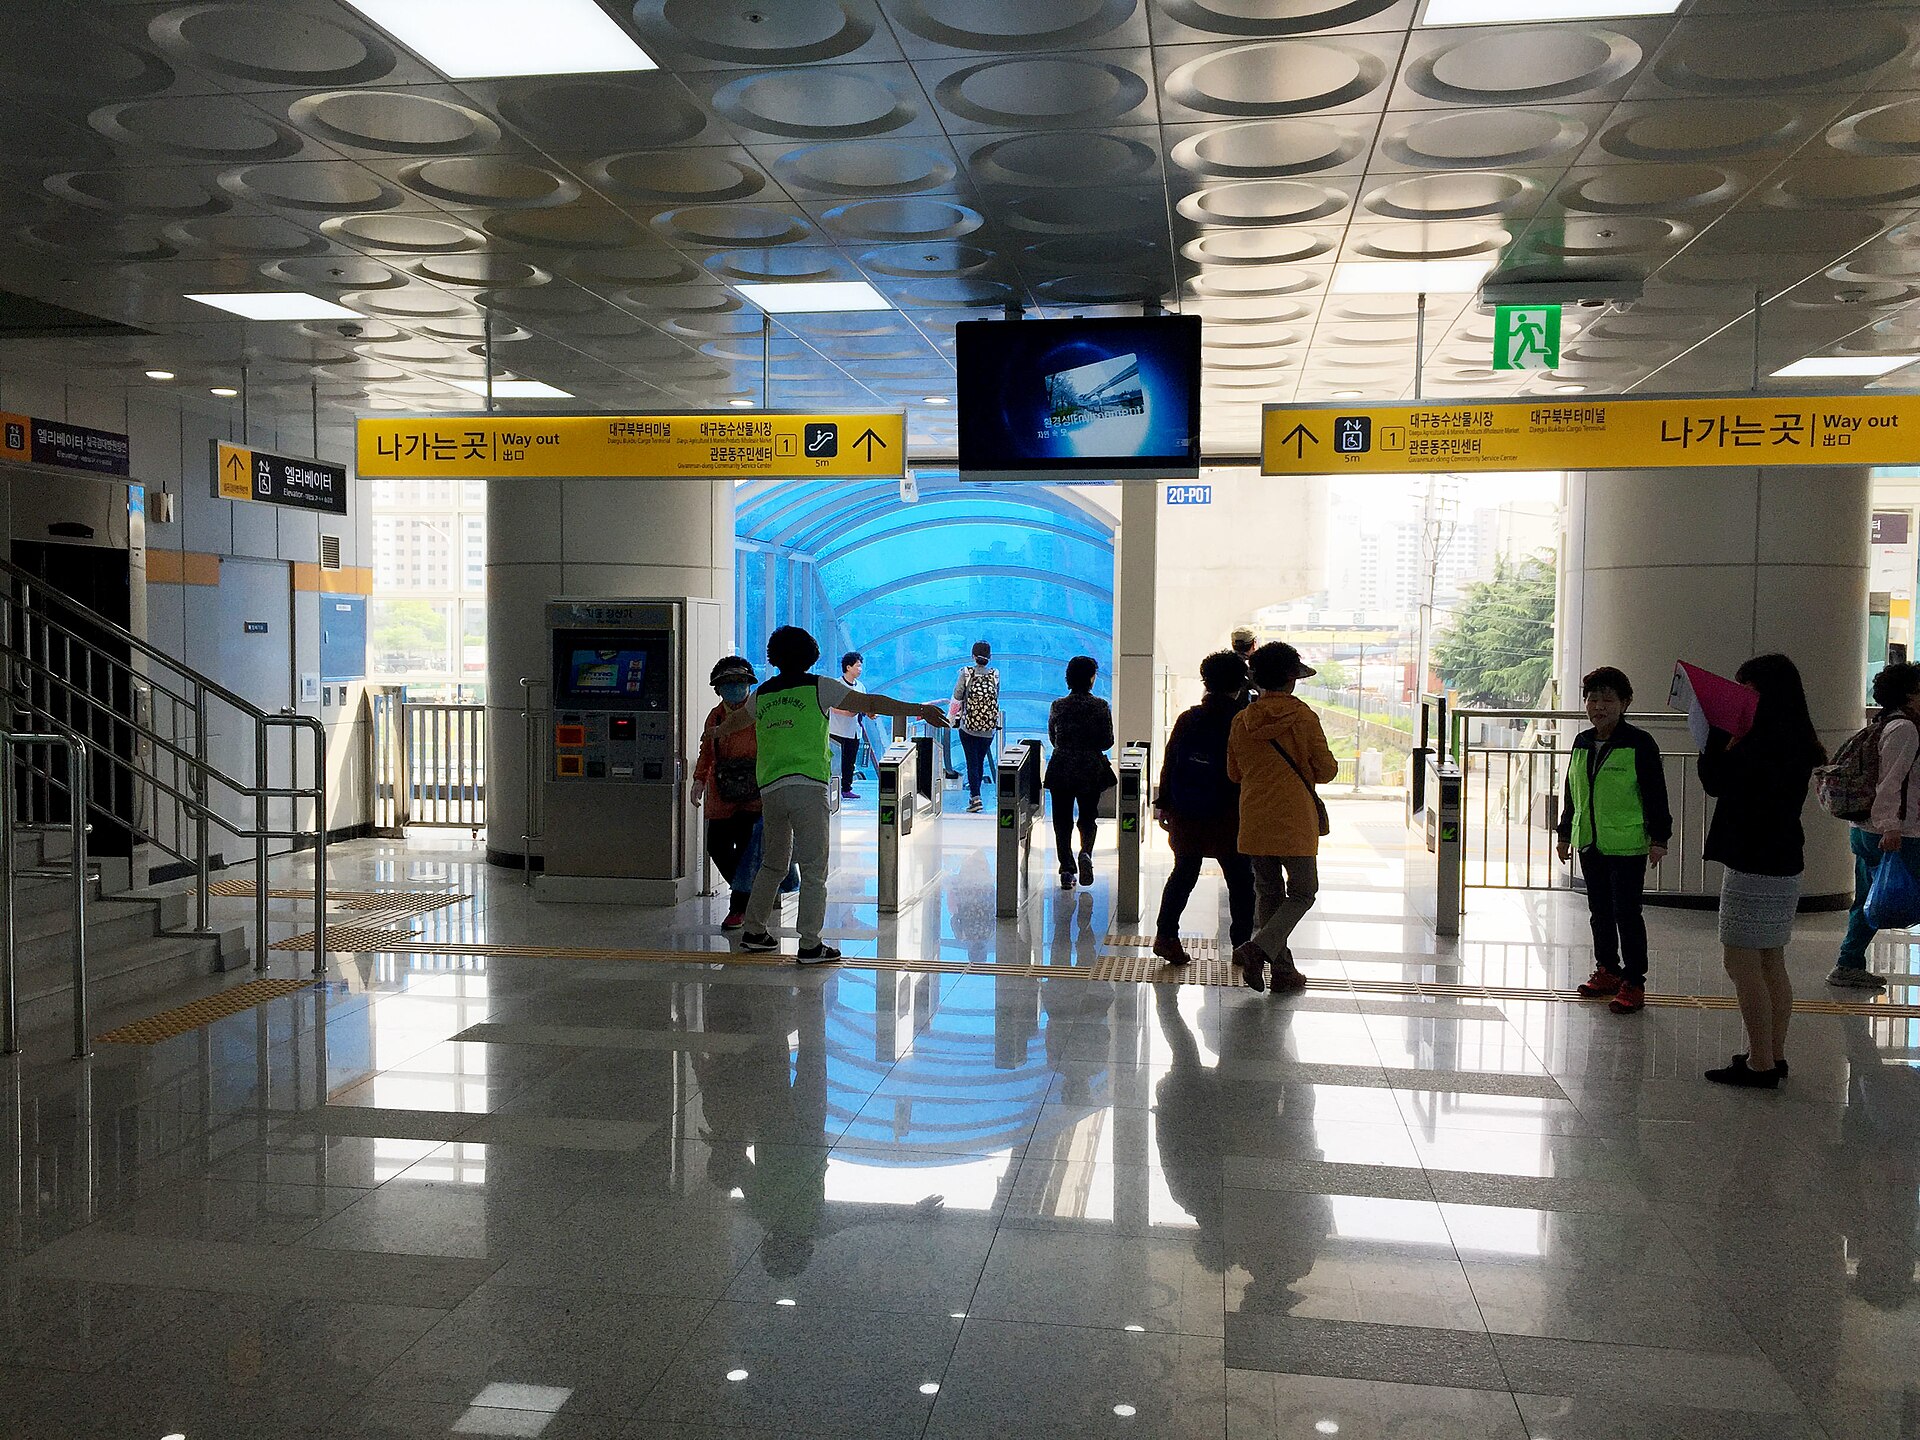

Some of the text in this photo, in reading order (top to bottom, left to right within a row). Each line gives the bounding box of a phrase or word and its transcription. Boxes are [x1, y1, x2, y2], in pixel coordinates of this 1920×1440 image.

[1410, 411, 1494, 428] 대구농수산물시장
[1530, 407, 1606, 425] 대구북부터미널
[1823, 413, 1899, 431] Way out
[609, 422, 671, 437] 대구북부터미널
[700, 422, 772, 437] 대구농수산물시장
[1566, 425, 1582, 433] Cargo
[501, 433, 560, 448] Way out
[783, 439, 789, 453] 1
[1389, 432, 1396, 446] 1
[1409, 438, 1482, 455] 관문동주민센터
[1823, 433, 1851, 447] 出口
[502, 449, 525, 461] 出口
[709, 447, 773, 462] 관문동주민센터
[1344, 454, 1360, 463] 5m
[1450, 455, 1481, 464] Community
[815, 459, 830, 468] 5m
[284, 465, 332, 492] 엘리베이터
[1168, 487, 1210, 503] 20-P01
